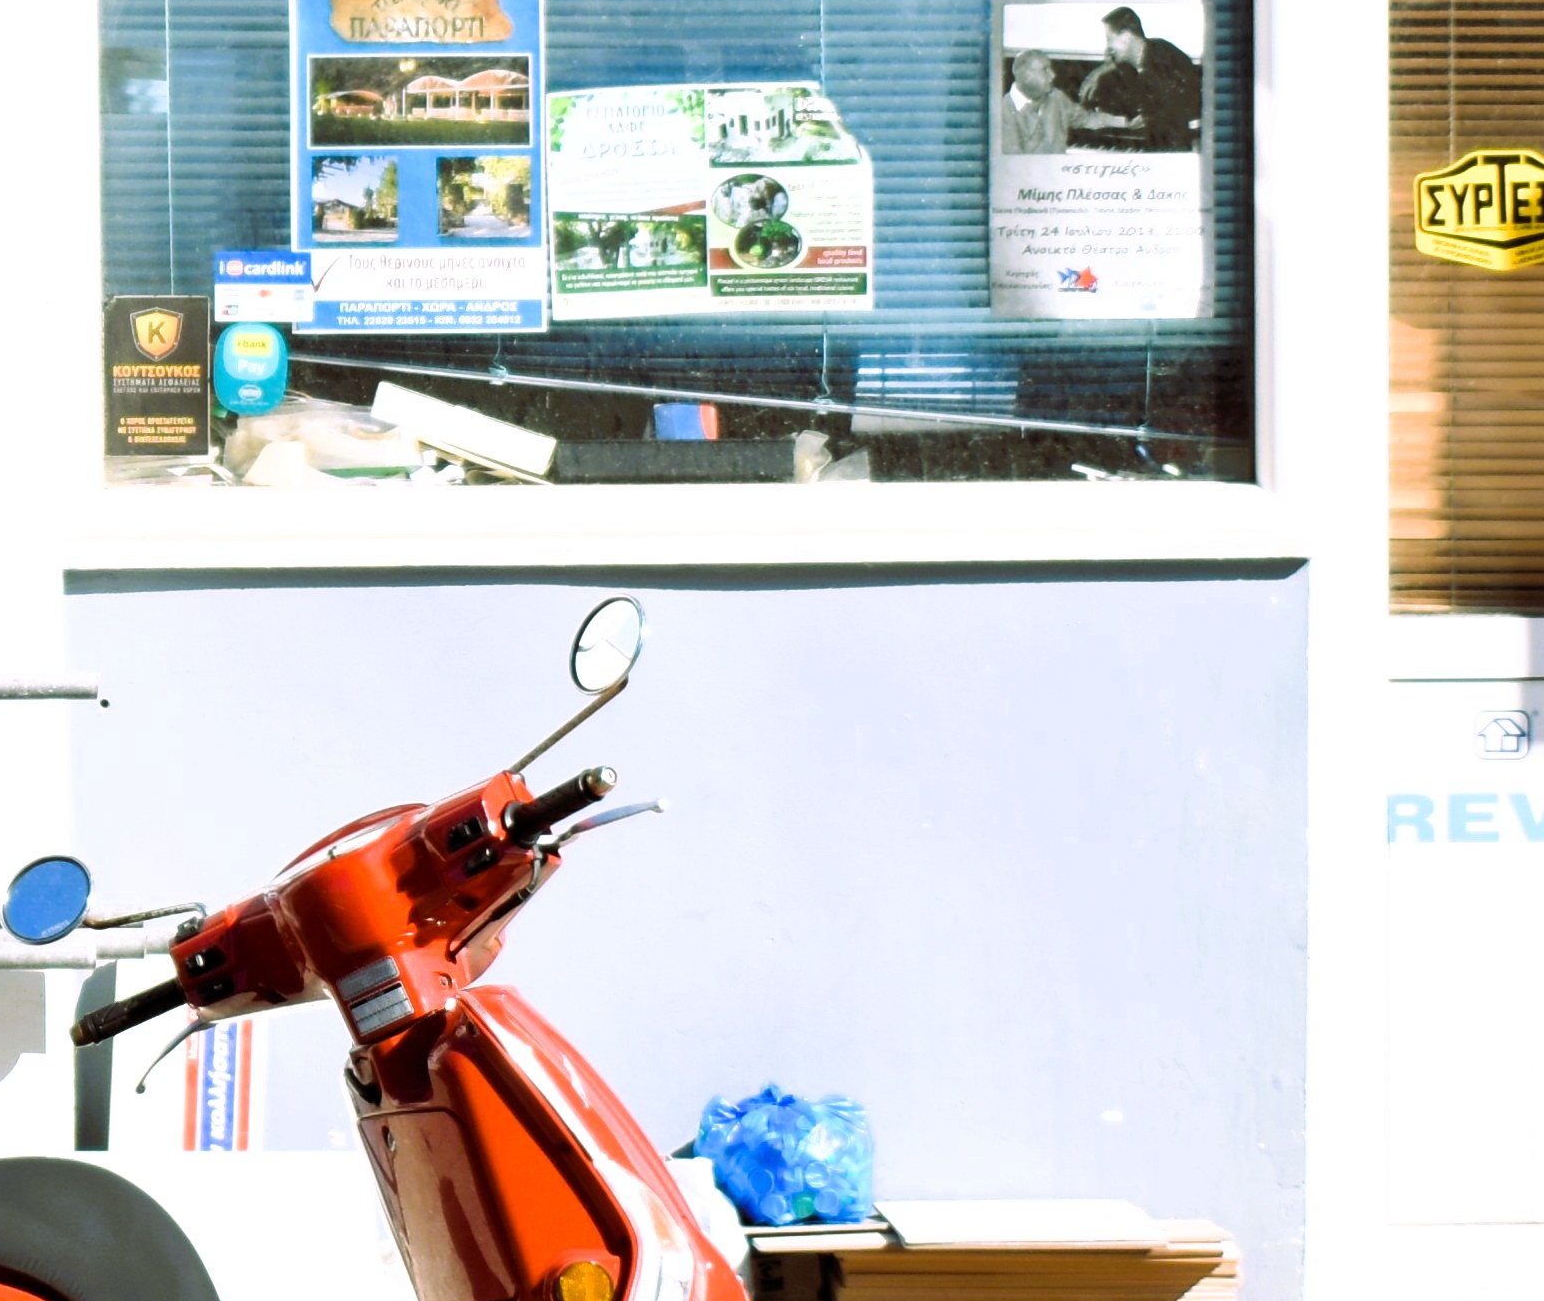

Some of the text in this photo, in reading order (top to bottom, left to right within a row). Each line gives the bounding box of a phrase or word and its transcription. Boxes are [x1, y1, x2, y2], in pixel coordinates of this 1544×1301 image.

[1066, 188, 1126, 203] Πλέσσας
[1132, 189, 1142, 200] &
[244, 260, 304, 276] cardlink
[113, 366, 201, 377] ΚΟΥΤΣΟΥΚΟΣ
